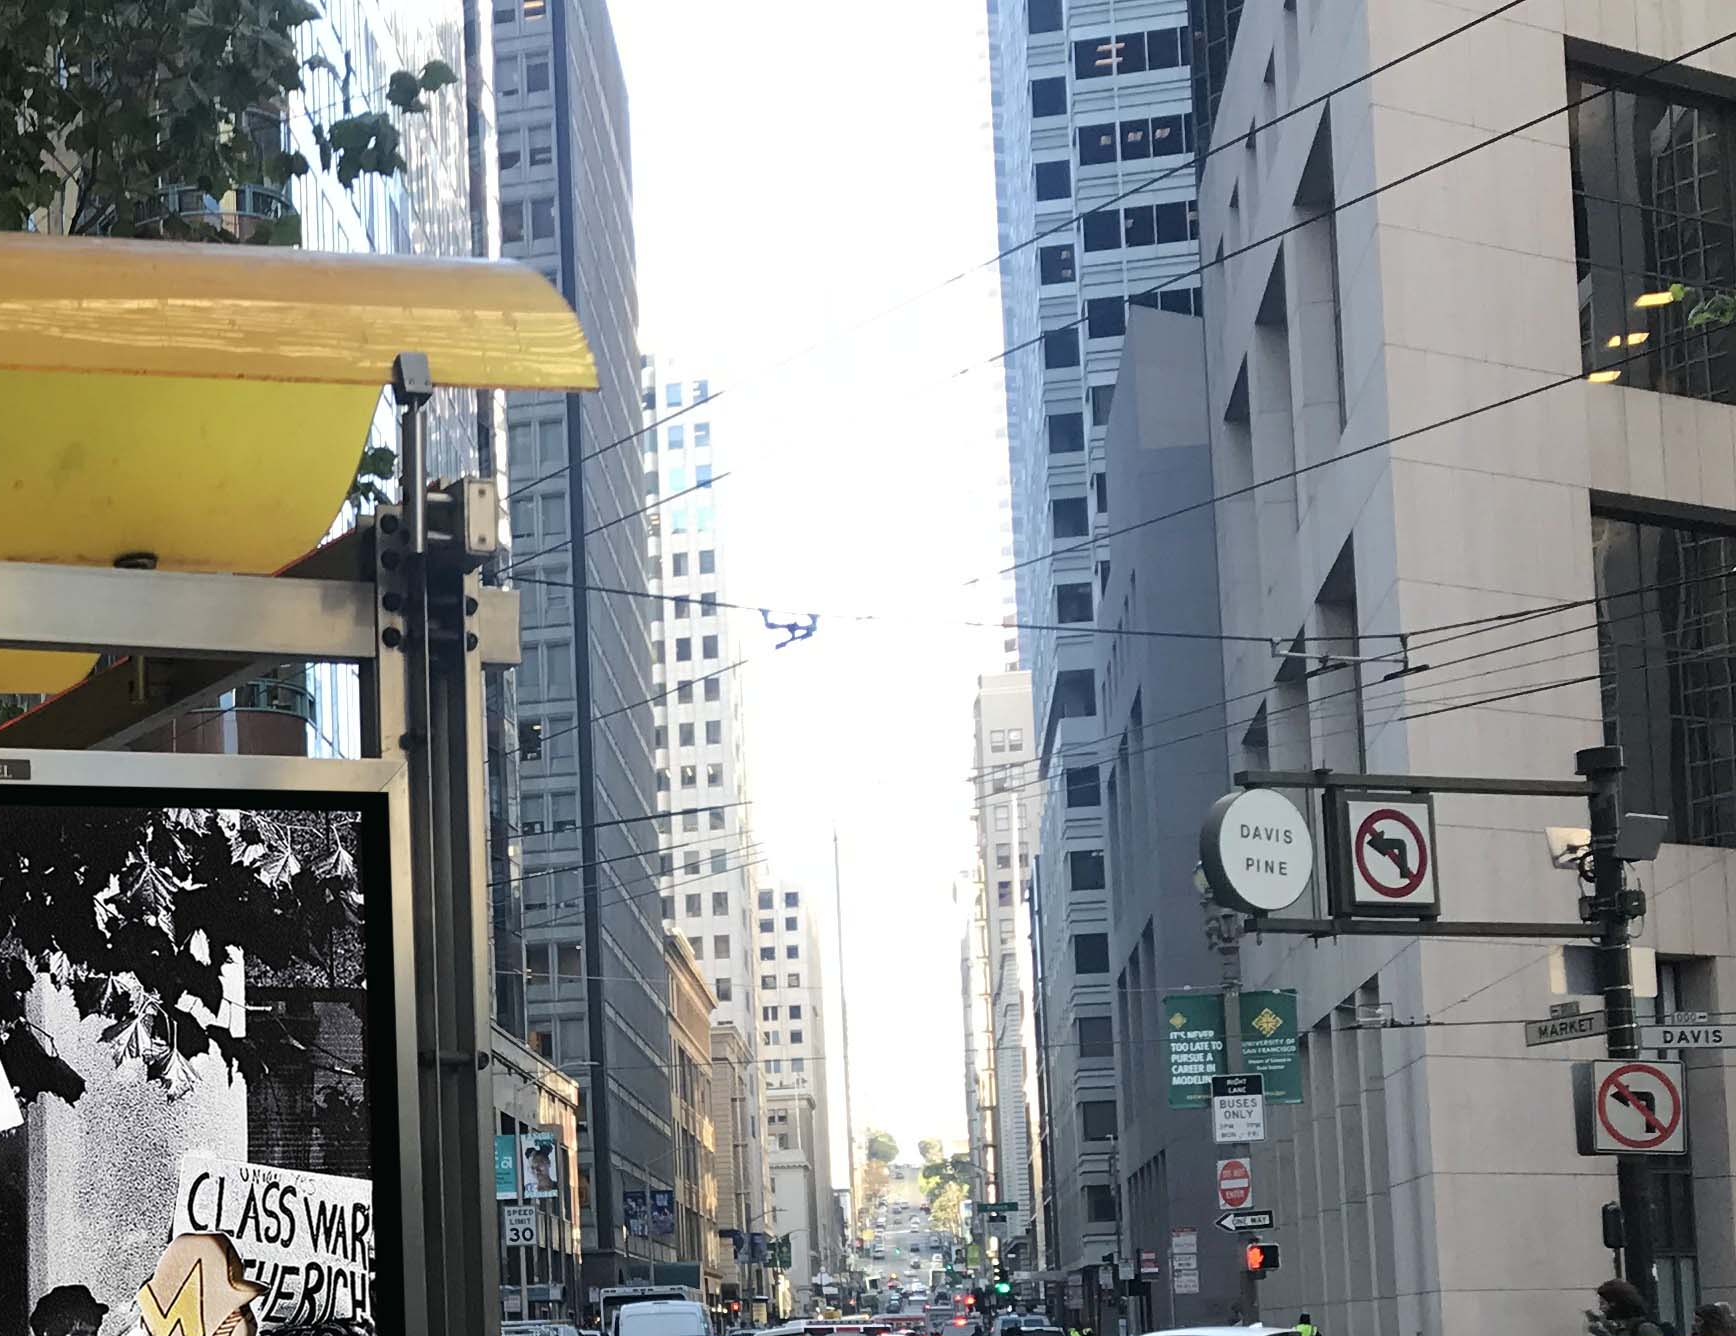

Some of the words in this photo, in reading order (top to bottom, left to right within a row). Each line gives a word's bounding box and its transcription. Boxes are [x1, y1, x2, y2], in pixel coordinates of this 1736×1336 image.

[1240, 824, 1293, 844] DAVIS
[1246, 857, 1287, 876] PINE
[1538, 1017, 1595, 1039] MARKET
[1186, 1030, 1215, 1039] NEVER
[1664, 1029, 1723, 1044] DAVIS
[1171, 1043, 1190, 1052] TOO
[1190, 1042, 1210, 1051] LATE
[1212, 1041, 1223, 1050] TO
[1171, 1053, 1205, 1063] PURSUE
[1206, 1053, 1214, 1061] A
[1171, 1064, 1206, 1074] CAREER
[1172, 1075, 1212, 1085] MODELIN
[1228, 1086, 1247, 1094] LANE
[1219, 1098, 1258, 1109] BUSES
[1224, 1109, 1254, 1120] ONLY
[507, 1208, 534, 1217] SPEED
[188, 1172, 297, 1248] CLASS
[304, 1196, 370, 1270] WAR
[509, 1217, 531, 1225] LIMIT
[1232, 1216, 1247, 1225] ONE
[1250, 1216, 1267, 1225] WAY
[509, 1227, 534, 1242] 30
